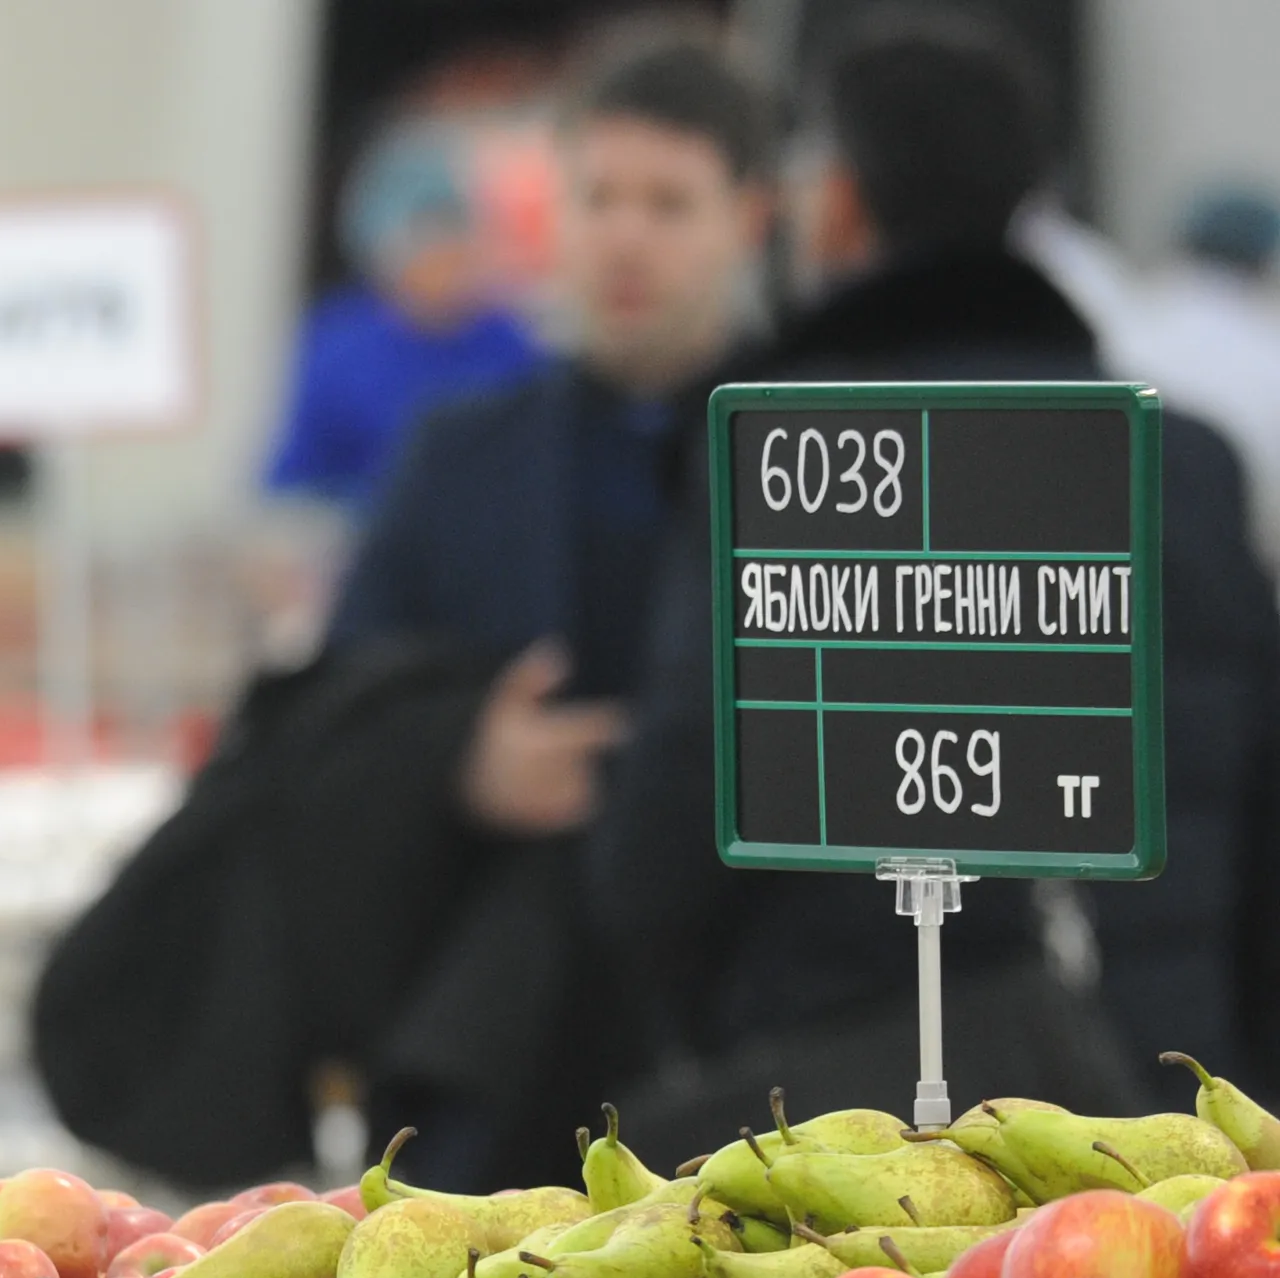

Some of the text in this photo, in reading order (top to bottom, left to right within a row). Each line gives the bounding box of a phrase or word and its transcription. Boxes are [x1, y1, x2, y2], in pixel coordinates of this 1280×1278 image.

[761, 428, 904, 517] 6038
[741, 562, 1132, 637] ЯБЛОКИ ГРЕННИ СМИТ
[896, 729, 1001, 817] 869
